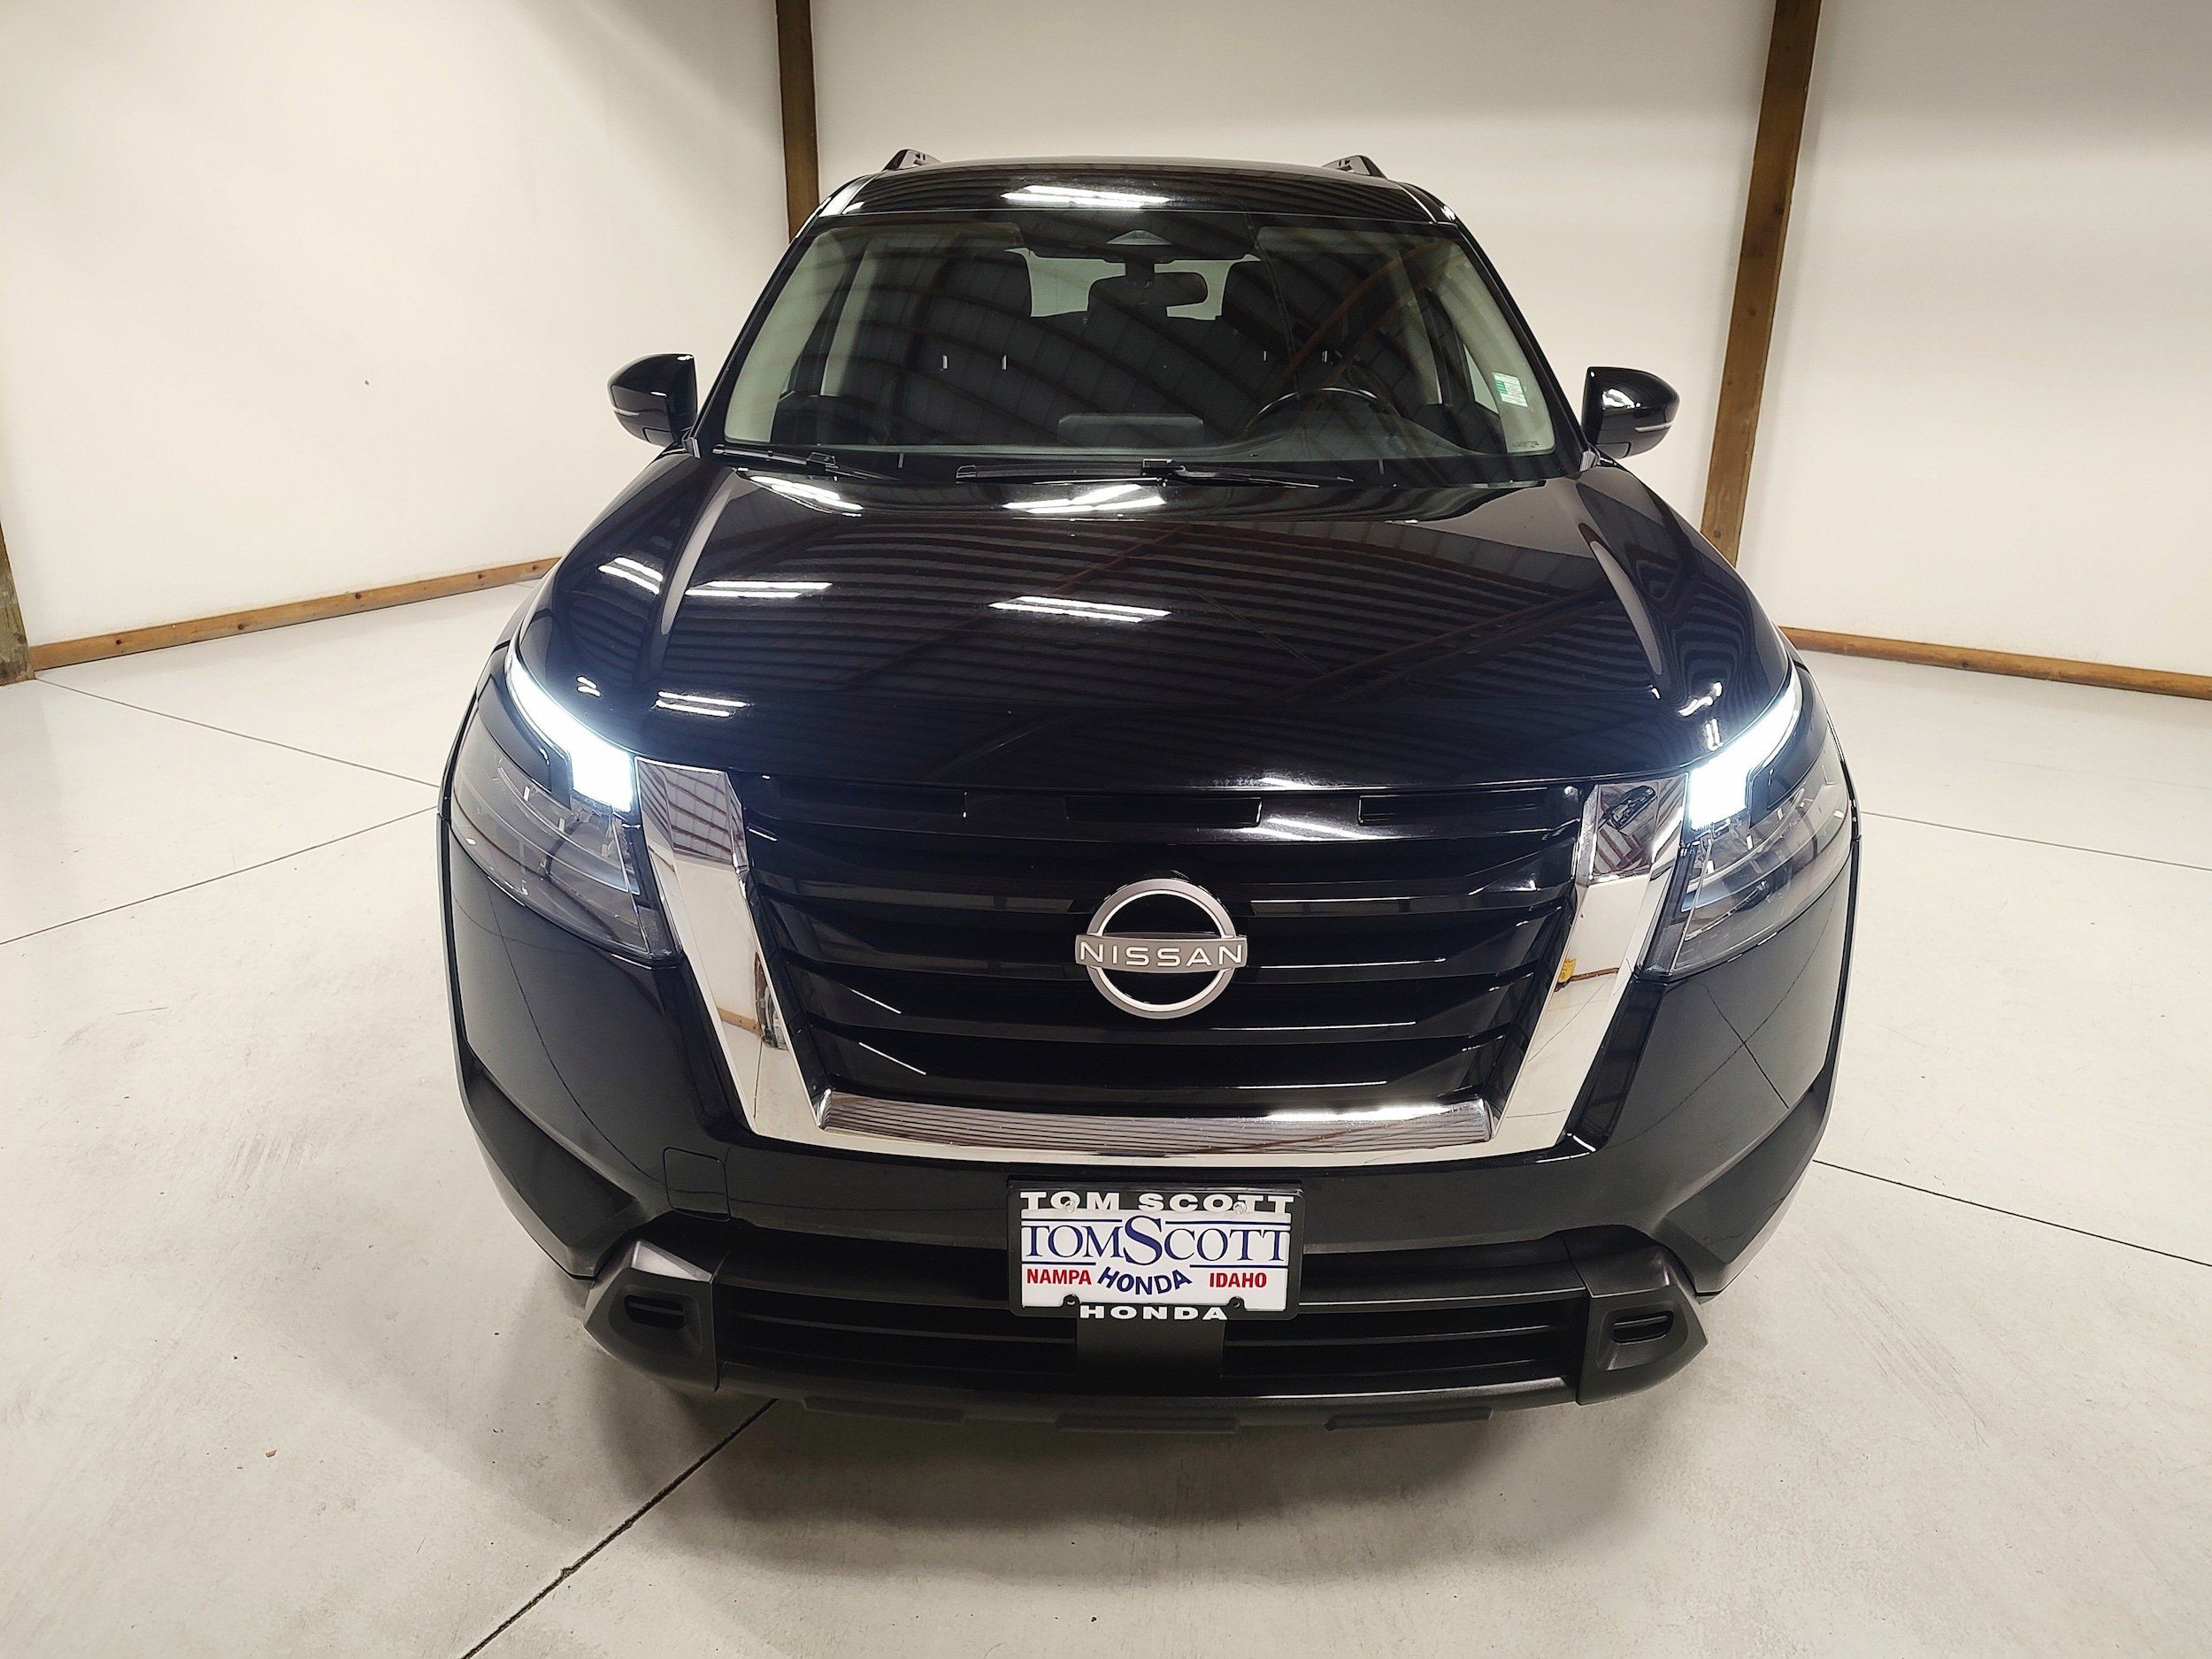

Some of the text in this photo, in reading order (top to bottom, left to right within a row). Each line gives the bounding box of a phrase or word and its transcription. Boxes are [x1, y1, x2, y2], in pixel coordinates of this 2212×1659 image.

[1079, 941, 1242, 966] NISSAN
[1020, 1191, 1294, 1213] TOM SCOTT
[1026, 1269, 1092, 1285] NAMPA
[1097, 1267, 1192, 1295] HONDA
[1210, 1272, 1267, 1288] IDAHO
[1079, 1305, 1228, 1321] HONDA
